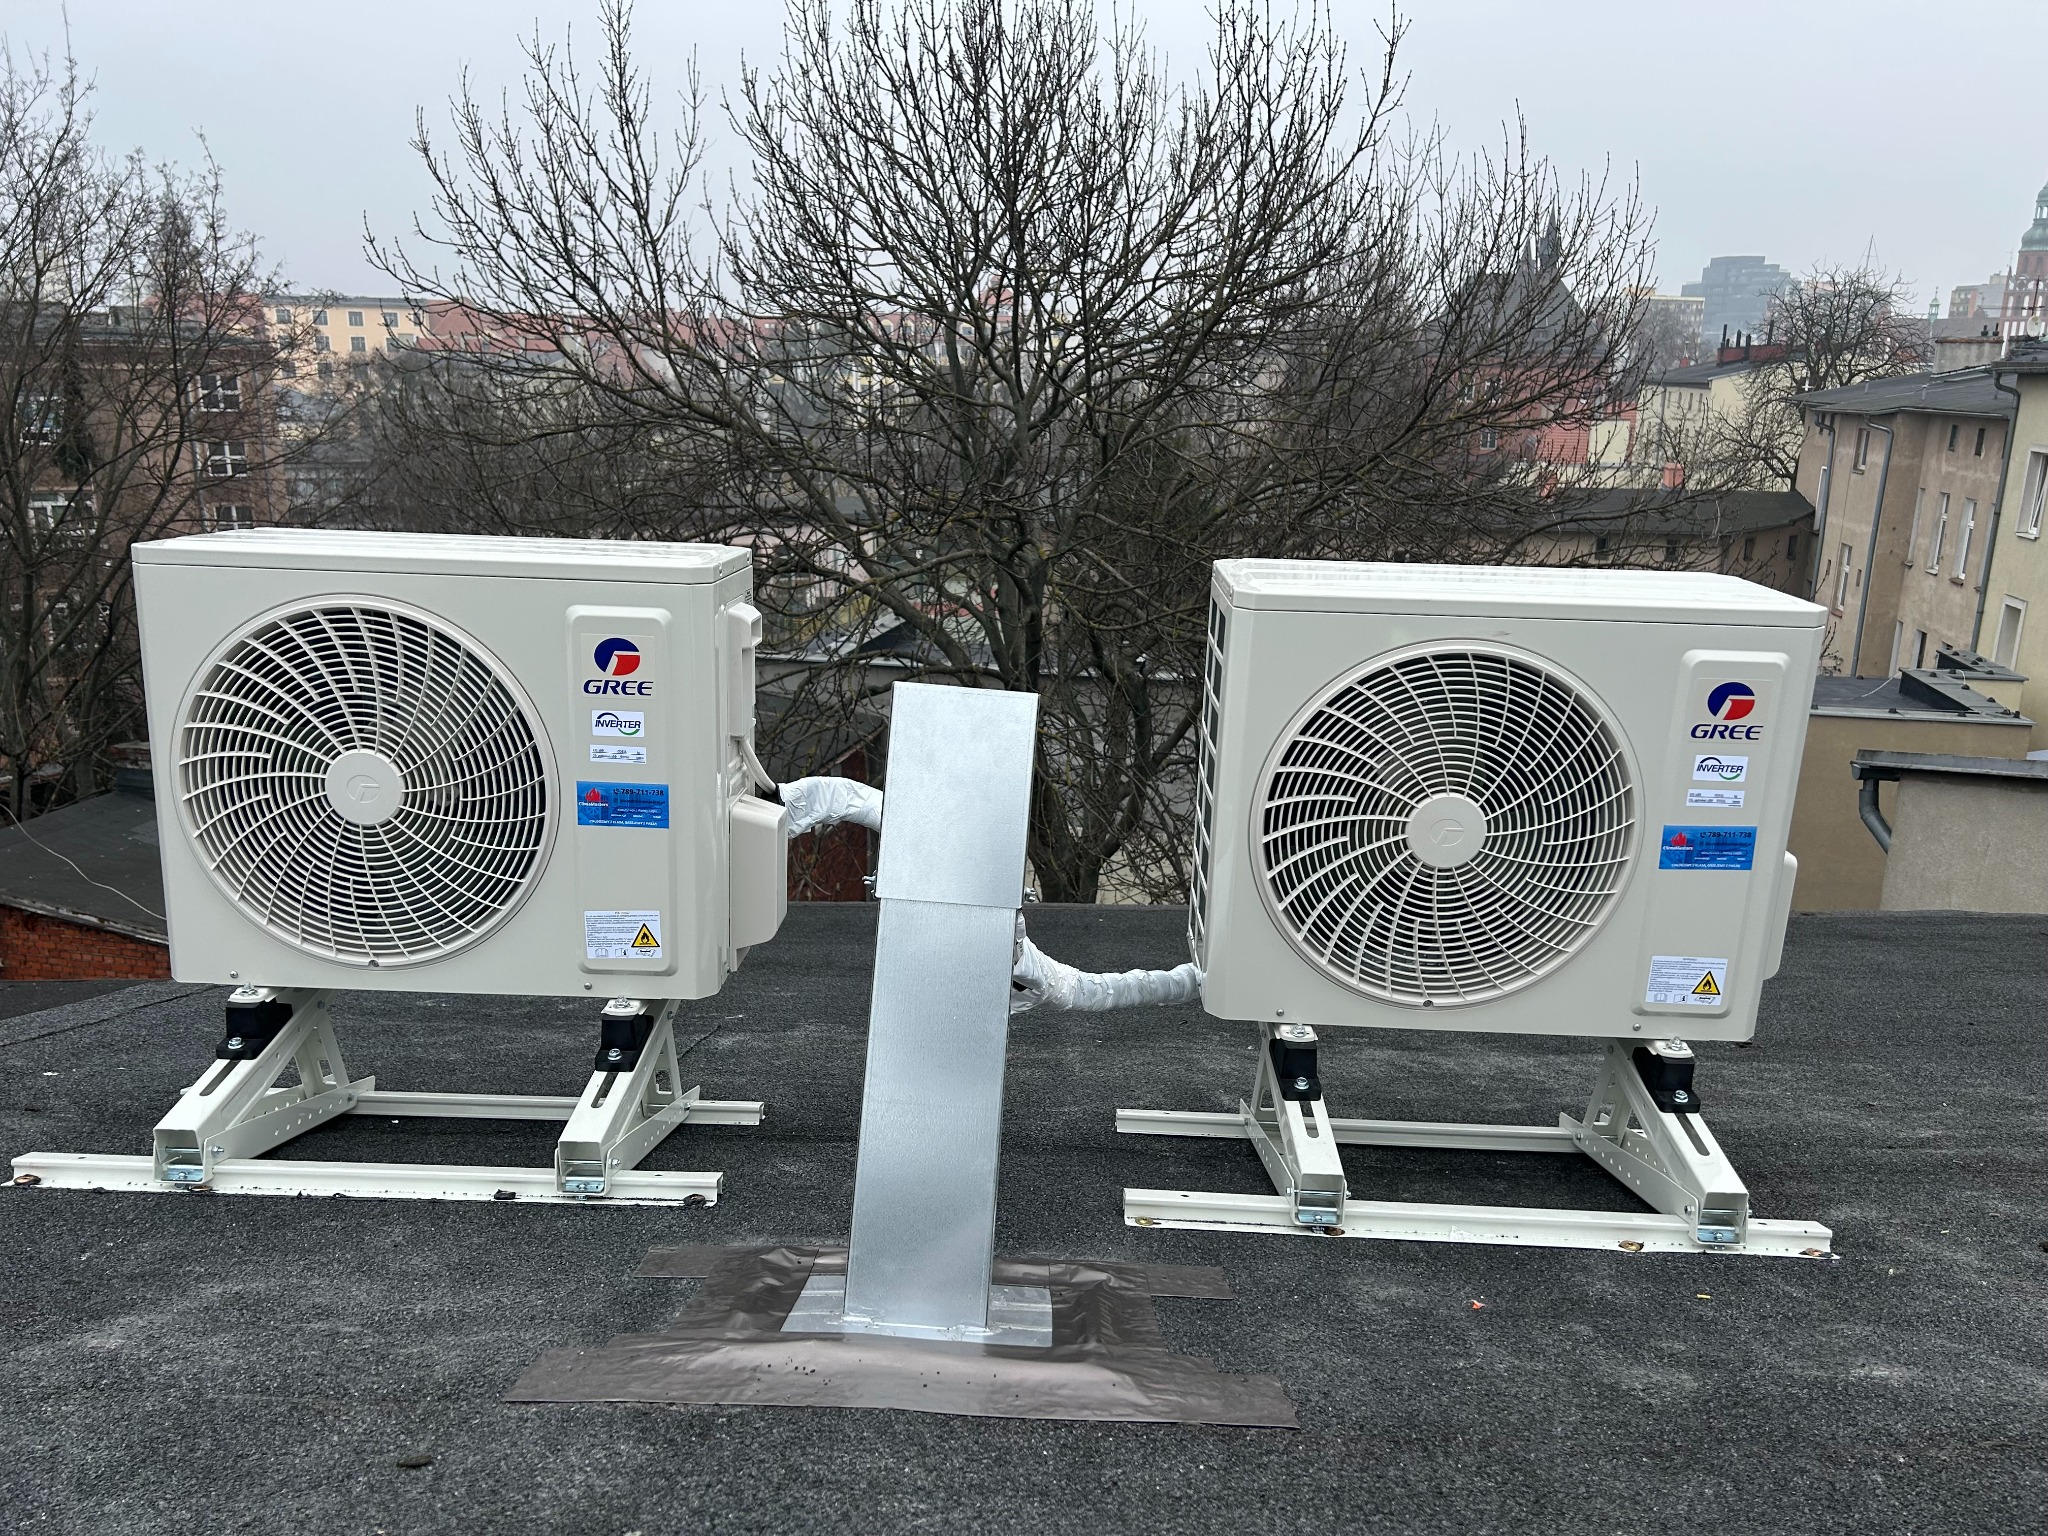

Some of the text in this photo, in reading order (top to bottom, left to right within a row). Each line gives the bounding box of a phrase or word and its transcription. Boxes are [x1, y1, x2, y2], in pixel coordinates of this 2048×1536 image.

[583, 679, 654, 696] GREE
[595, 719, 642, 729] INVERTER
[1690, 723, 1764, 741] GREE
[1696, 763, 1744, 774] INVERTER
[621, 788, 664, 796] 789-711-738
